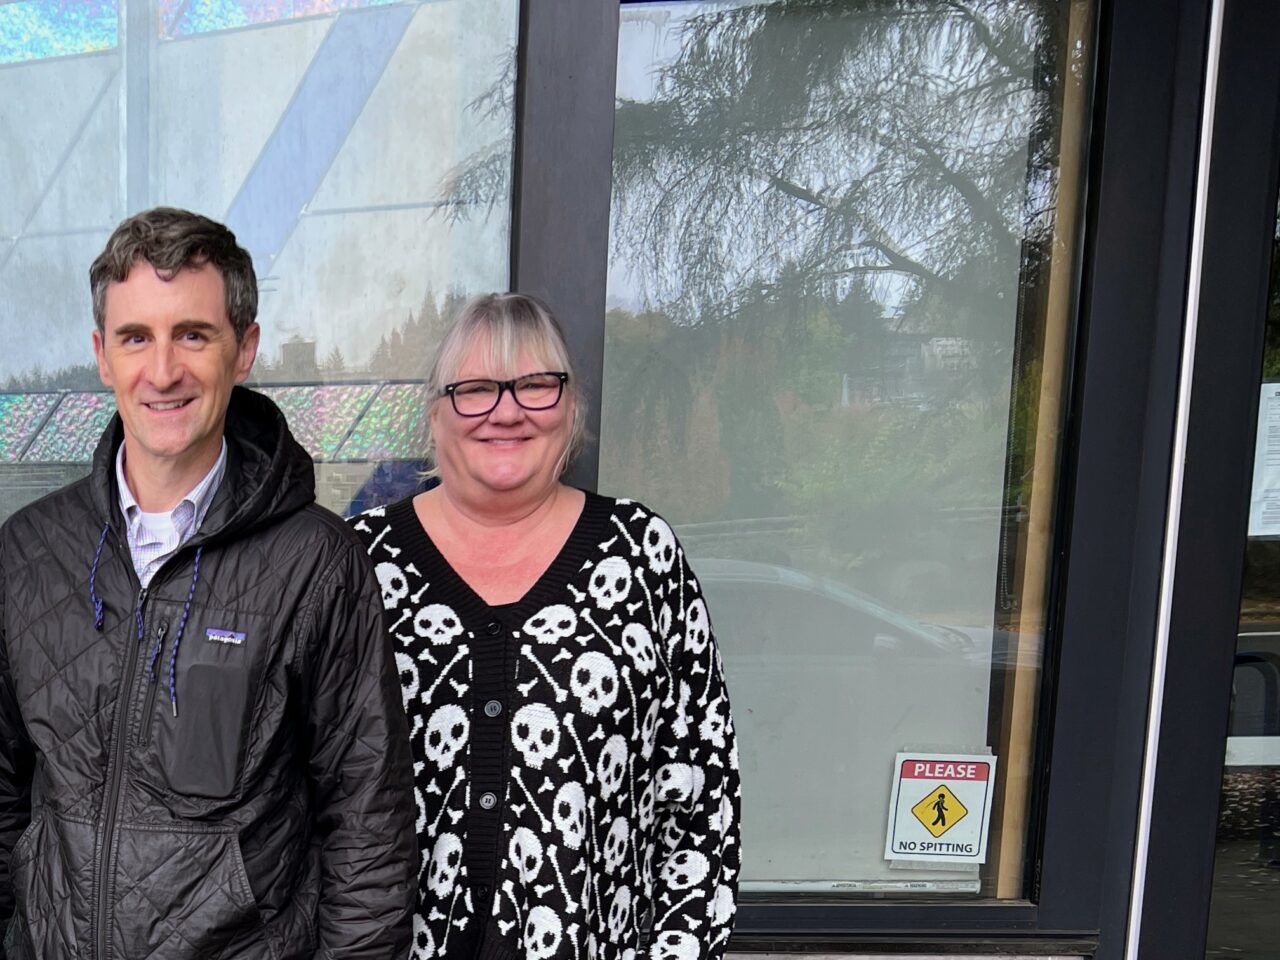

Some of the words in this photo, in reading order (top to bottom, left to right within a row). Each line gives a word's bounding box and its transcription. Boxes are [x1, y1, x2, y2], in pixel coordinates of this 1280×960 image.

[914, 763, 977, 778] PLEASE
[899, 841, 917, 851] NO
[919, 842, 973, 853] SPITTING
